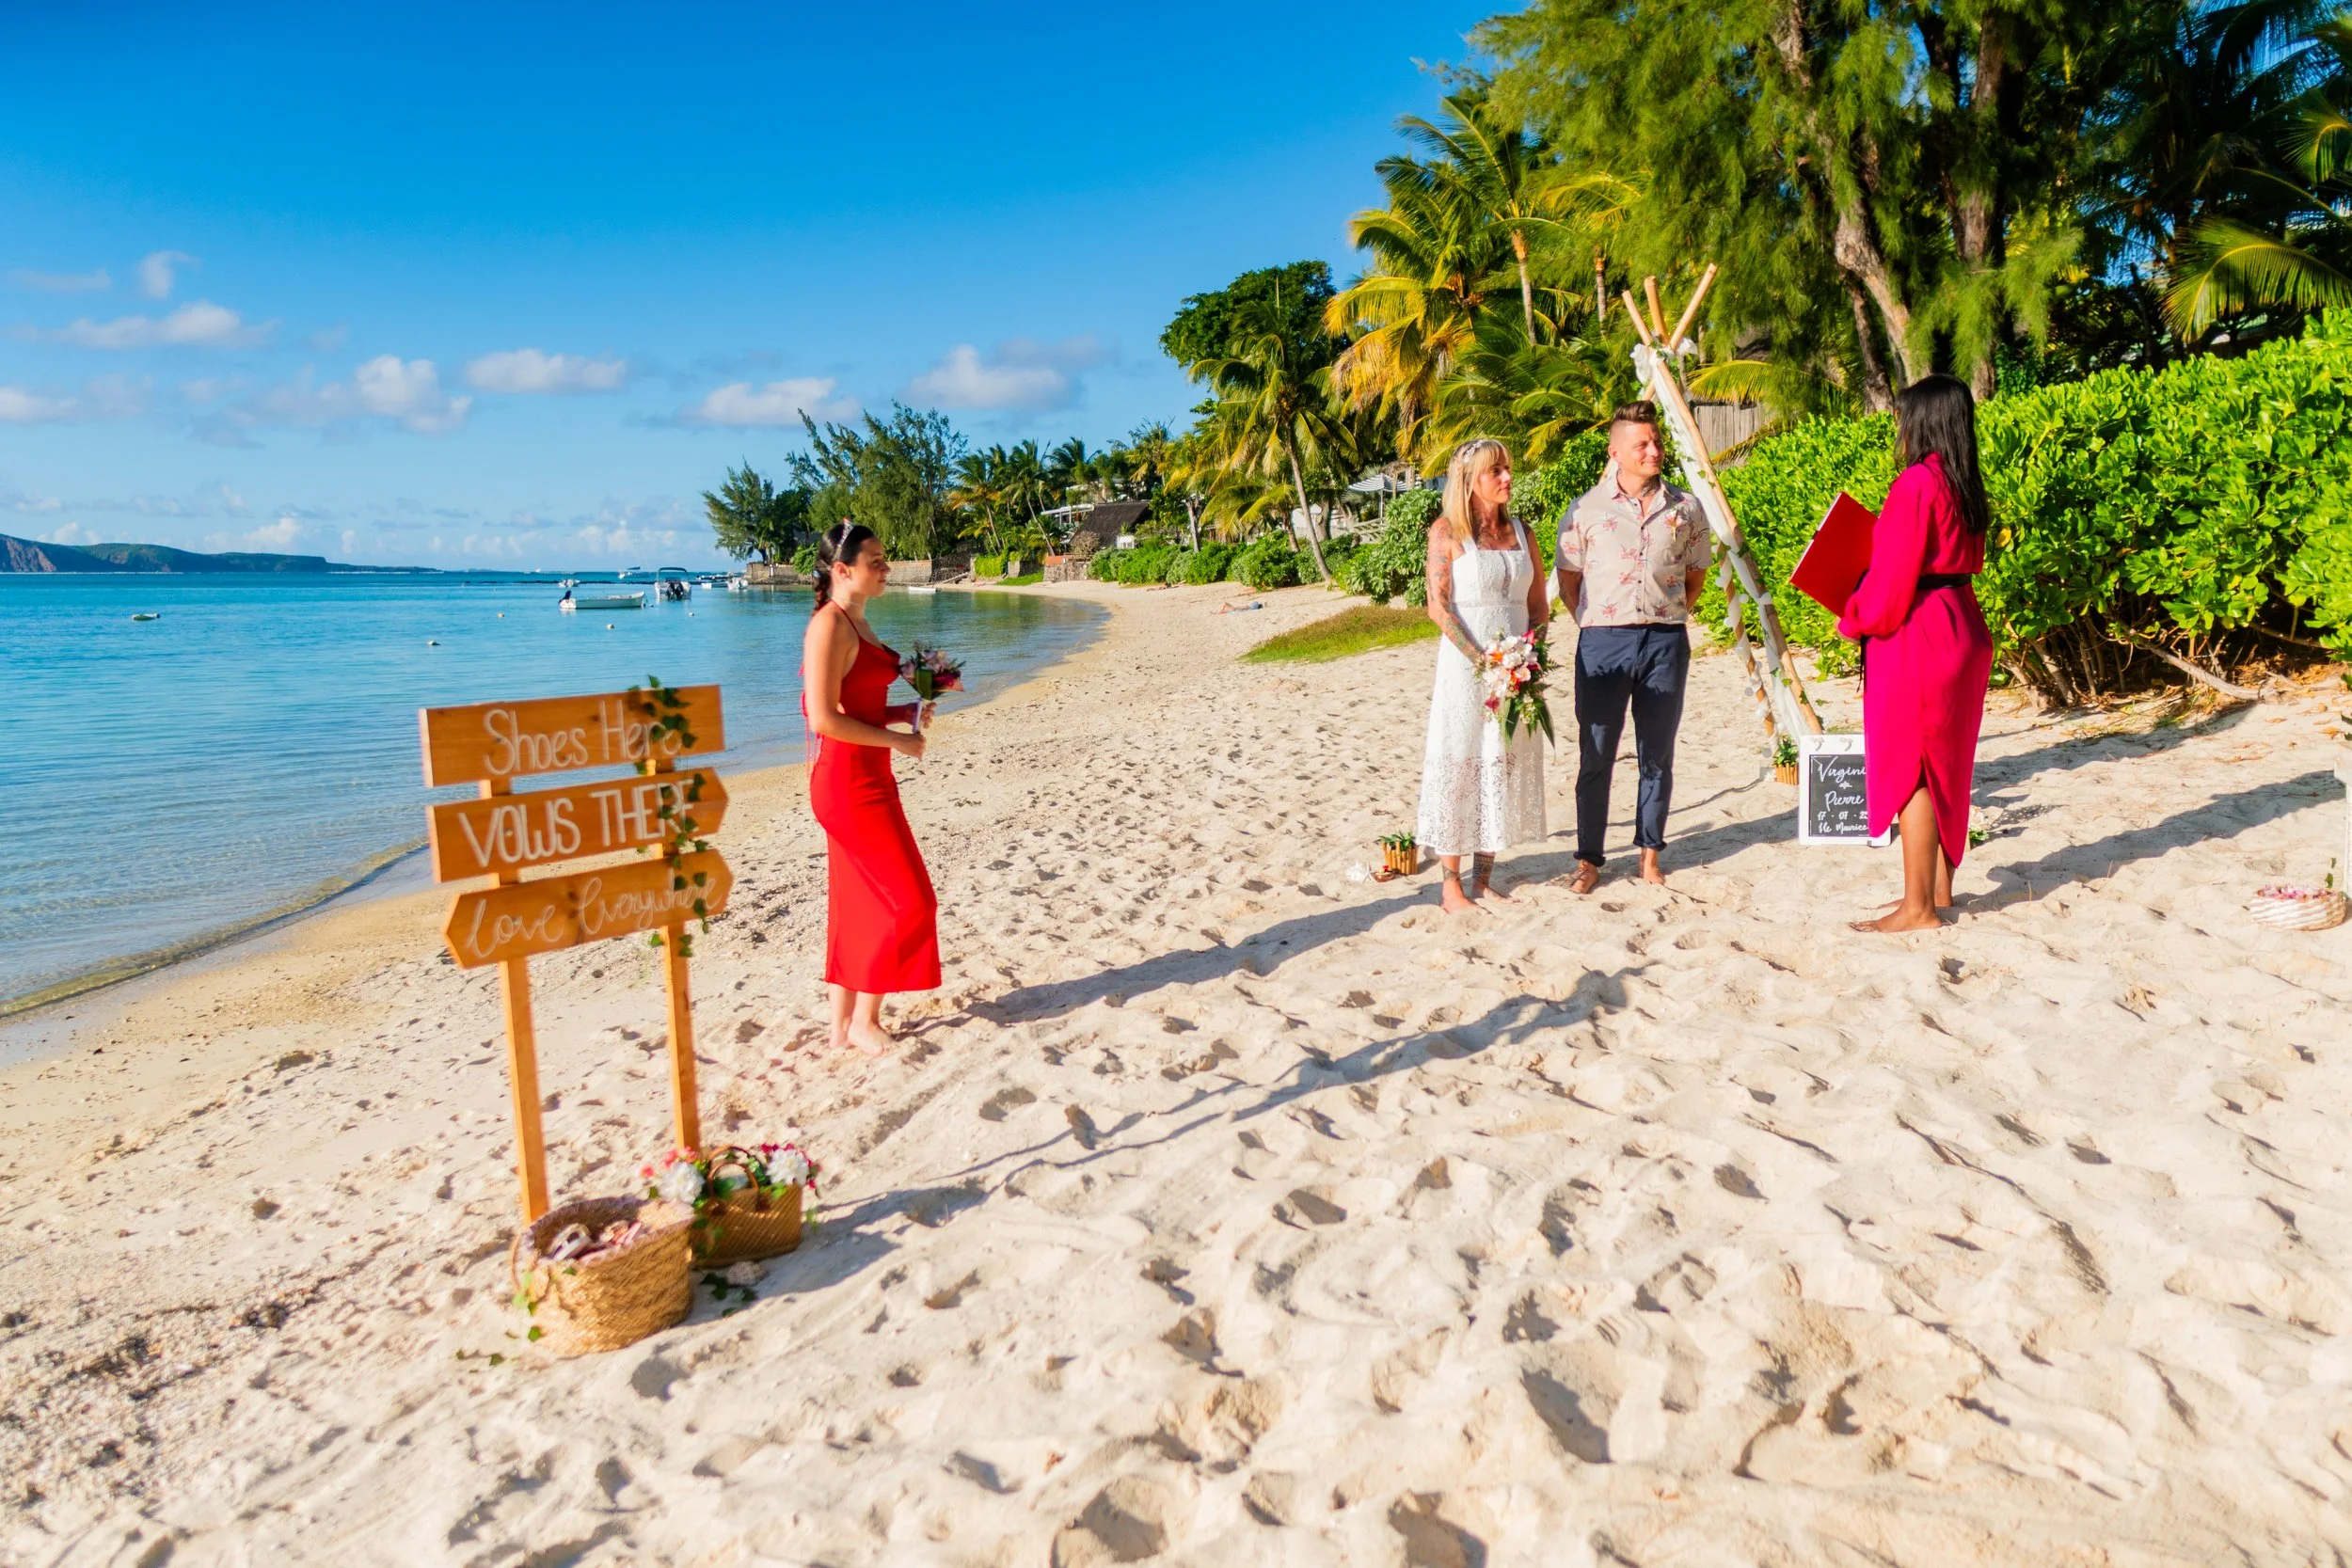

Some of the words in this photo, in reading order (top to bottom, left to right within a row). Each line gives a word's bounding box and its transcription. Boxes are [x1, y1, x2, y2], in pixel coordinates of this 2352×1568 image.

[483, 708, 588, 775] Shoes
[598, 699, 682, 761] Here
[1817, 755, 1867, 783] Virgini
[458, 797, 581, 868] VOWS
[589, 778, 700, 847] THERE
[1823, 790, 1865, 812] Pierre
[466, 897, 565, 958] Love
